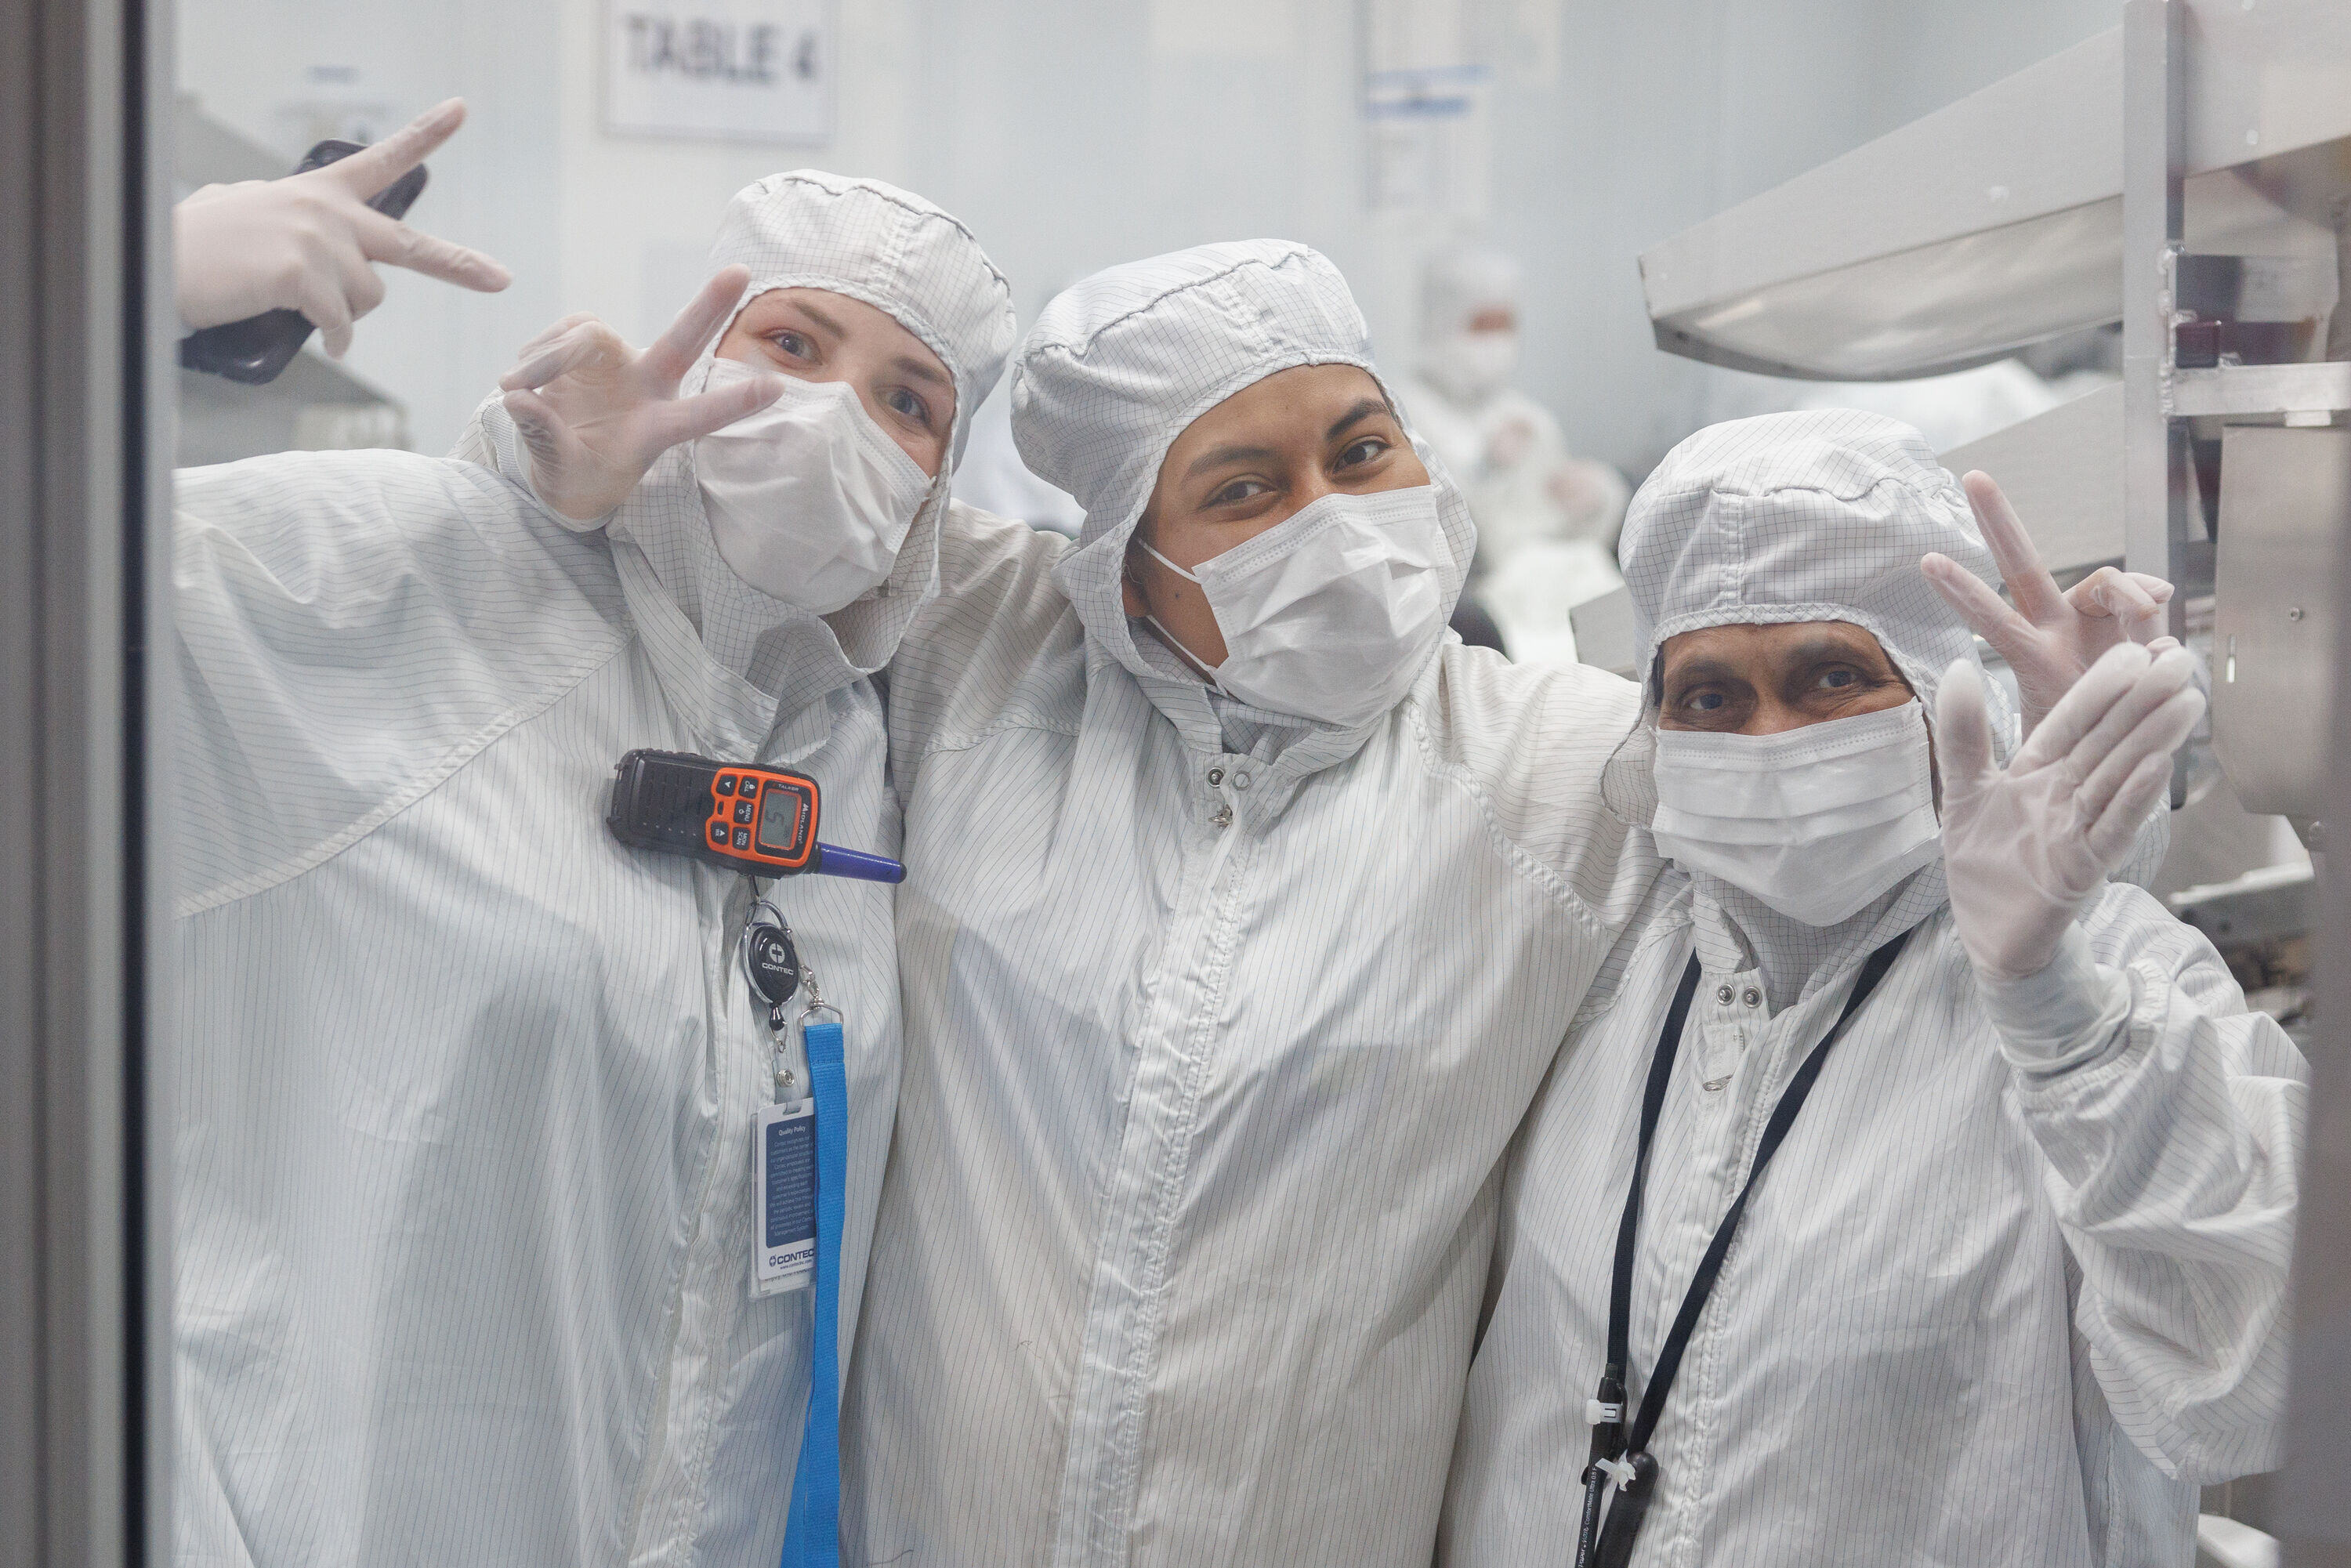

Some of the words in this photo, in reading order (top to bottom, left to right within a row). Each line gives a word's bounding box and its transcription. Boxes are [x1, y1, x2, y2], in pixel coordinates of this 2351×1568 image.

[626, 14, 779, 85] TABLE
[762, 962, 794, 976] CONTEC
[778, 1128, 794, 1136] Quality
[777, 1248, 815, 1265] CONTEC
